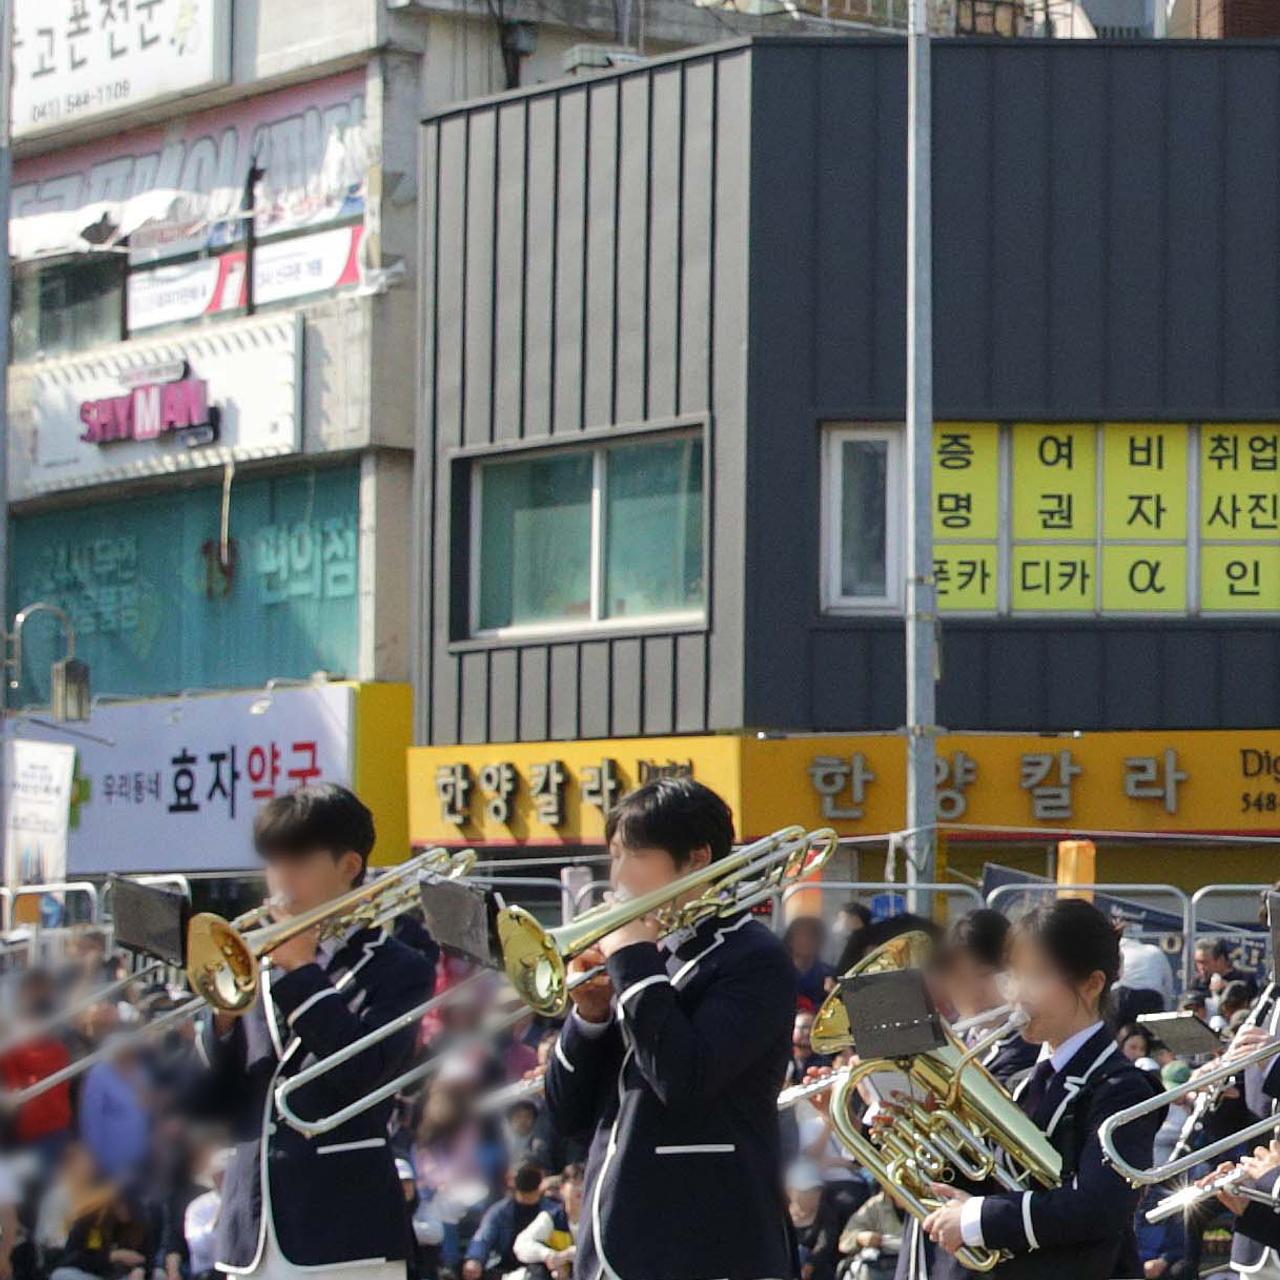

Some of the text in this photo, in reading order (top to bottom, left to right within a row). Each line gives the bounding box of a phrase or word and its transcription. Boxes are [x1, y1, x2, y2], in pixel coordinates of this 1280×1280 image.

[1207, 434, 1279, 472] 취업
[1207, 493, 1279, 531] 사진
[1021, 558, 1090, 595] 디카
